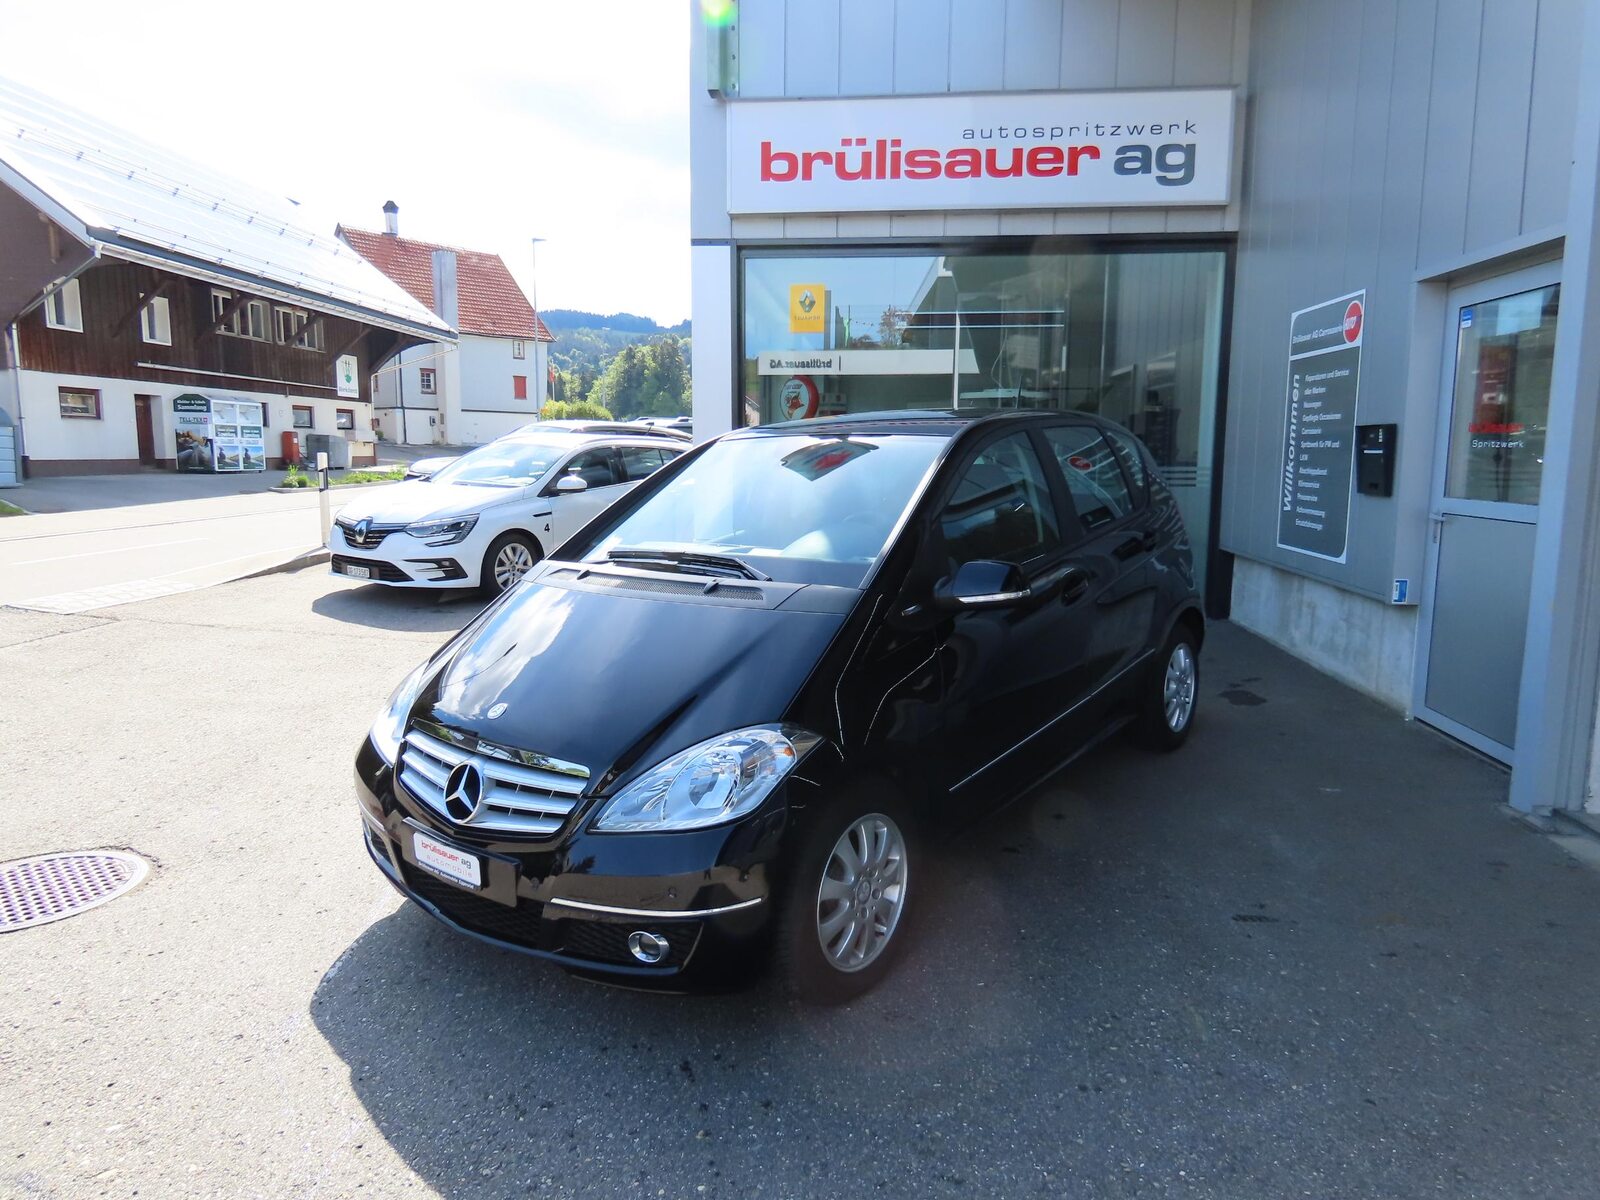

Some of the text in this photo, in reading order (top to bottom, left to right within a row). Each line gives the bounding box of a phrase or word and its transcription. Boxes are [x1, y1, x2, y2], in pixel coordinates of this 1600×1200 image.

[962, 120, 1197, 141] autospritzwerk
[760, 137, 1197, 187] brülisauer ag
[1282, 374, 1300, 511] Willkommen
[1472, 439, 1524, 449] Spritzwerk
[544, 523, 550, 532] 4
[421, 840, 472, 870] brülisauer ag
